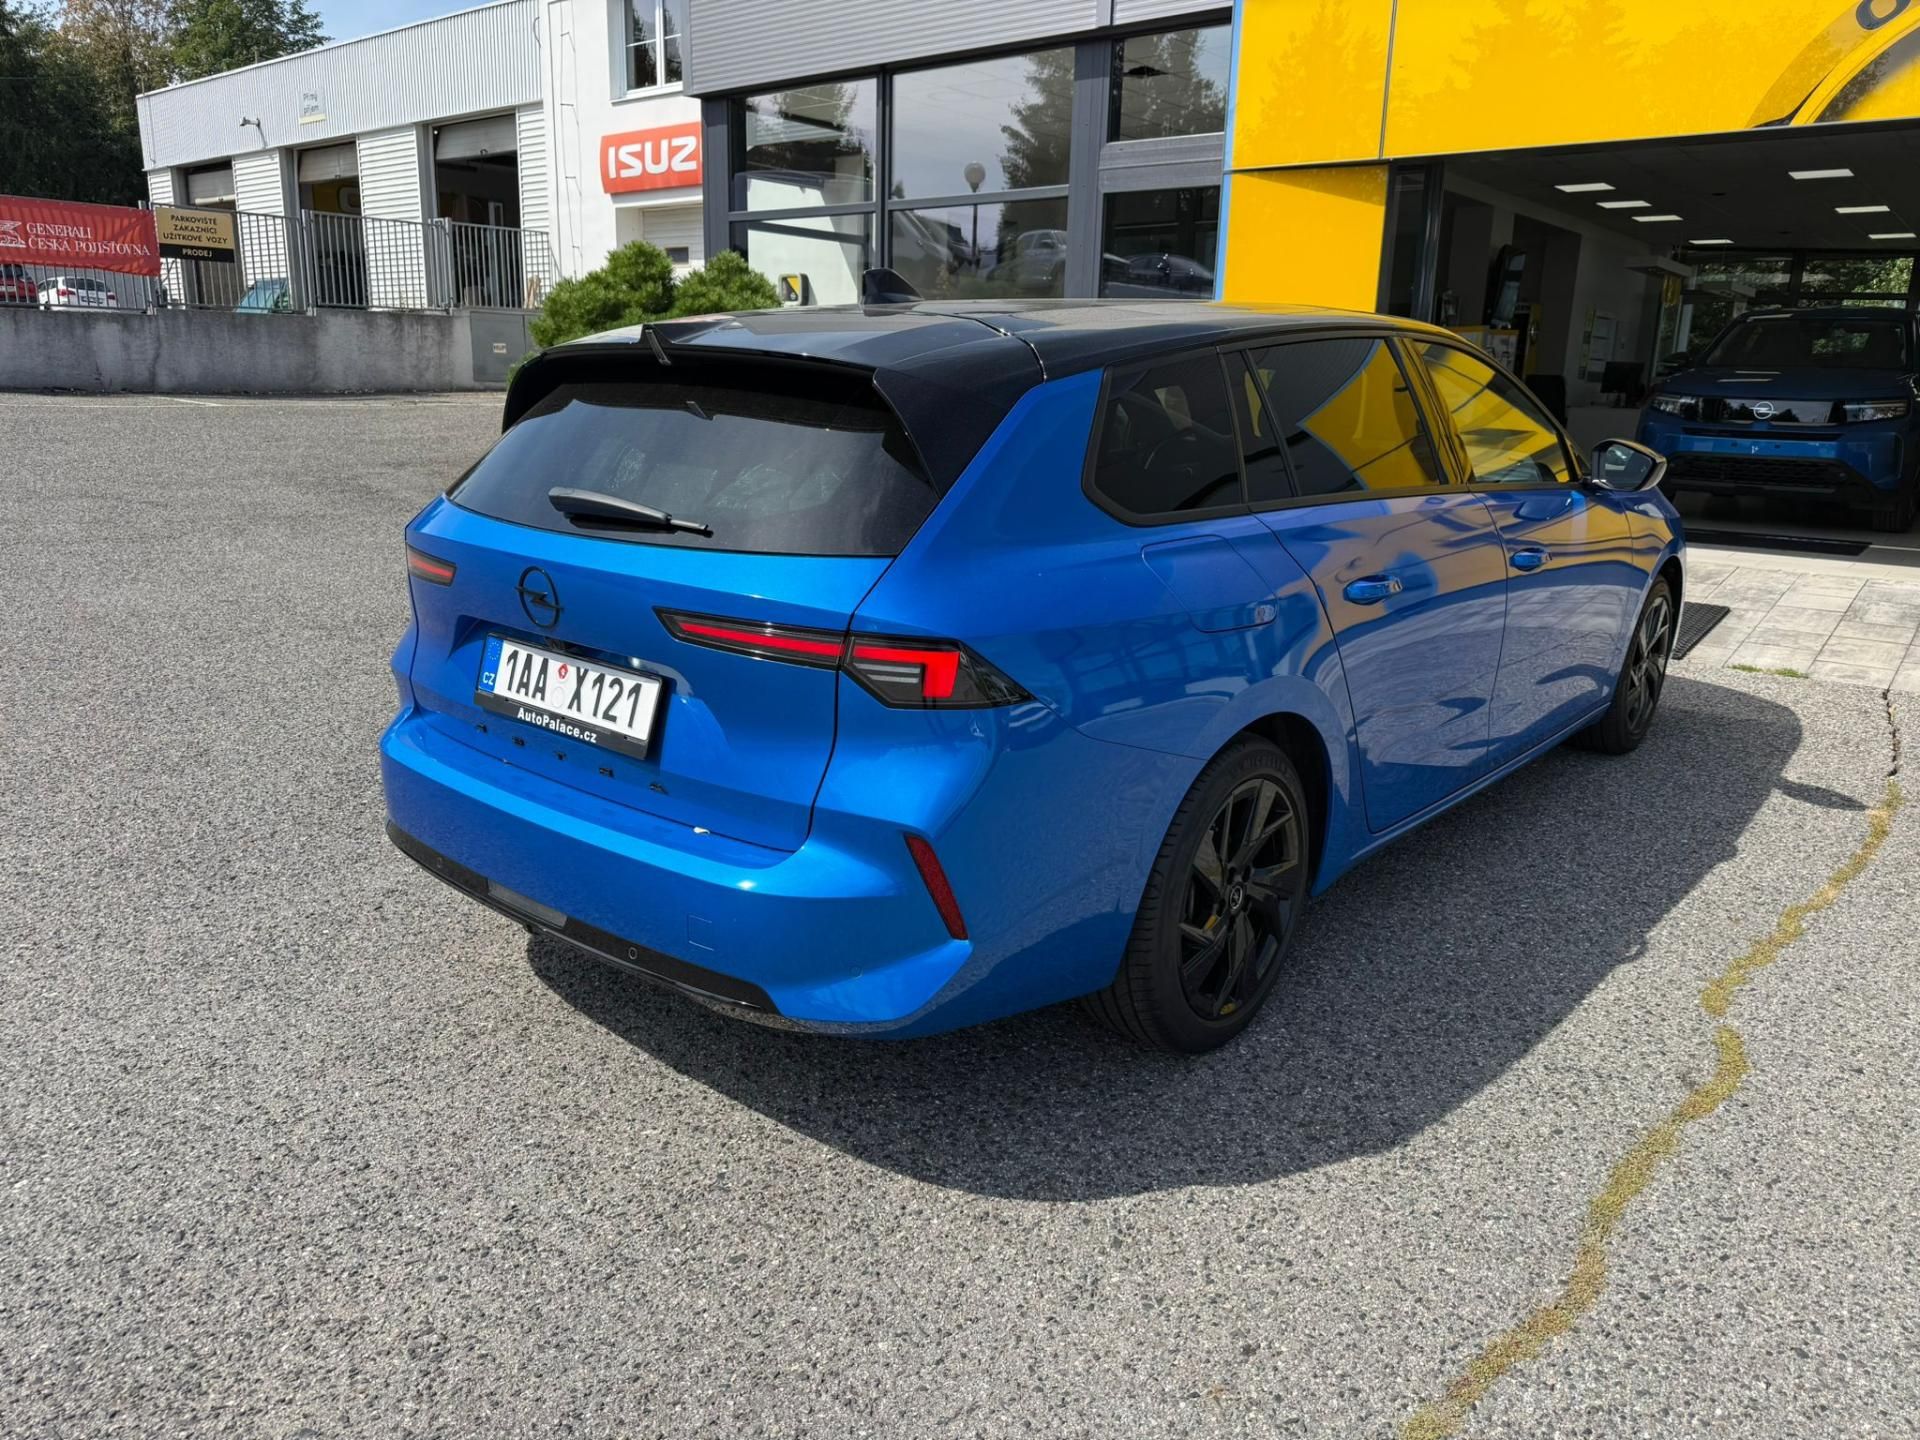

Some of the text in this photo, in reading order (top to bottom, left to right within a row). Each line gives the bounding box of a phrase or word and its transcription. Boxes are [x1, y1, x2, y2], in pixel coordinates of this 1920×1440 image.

[607, 135, 702, 179] ISUZ
[25, 221, 91, 239] GENERALI
[28, 236, 71, 252] ČESKÁ
[206, 235, 228, 244] VOZY
[182, 247, 213, 258] PRODEJ
[482, 671, 496, 687] CZ
[506, 649, 643, 730] 1AA X121
[516, 706, 598, 744] AutoPalace.cz
